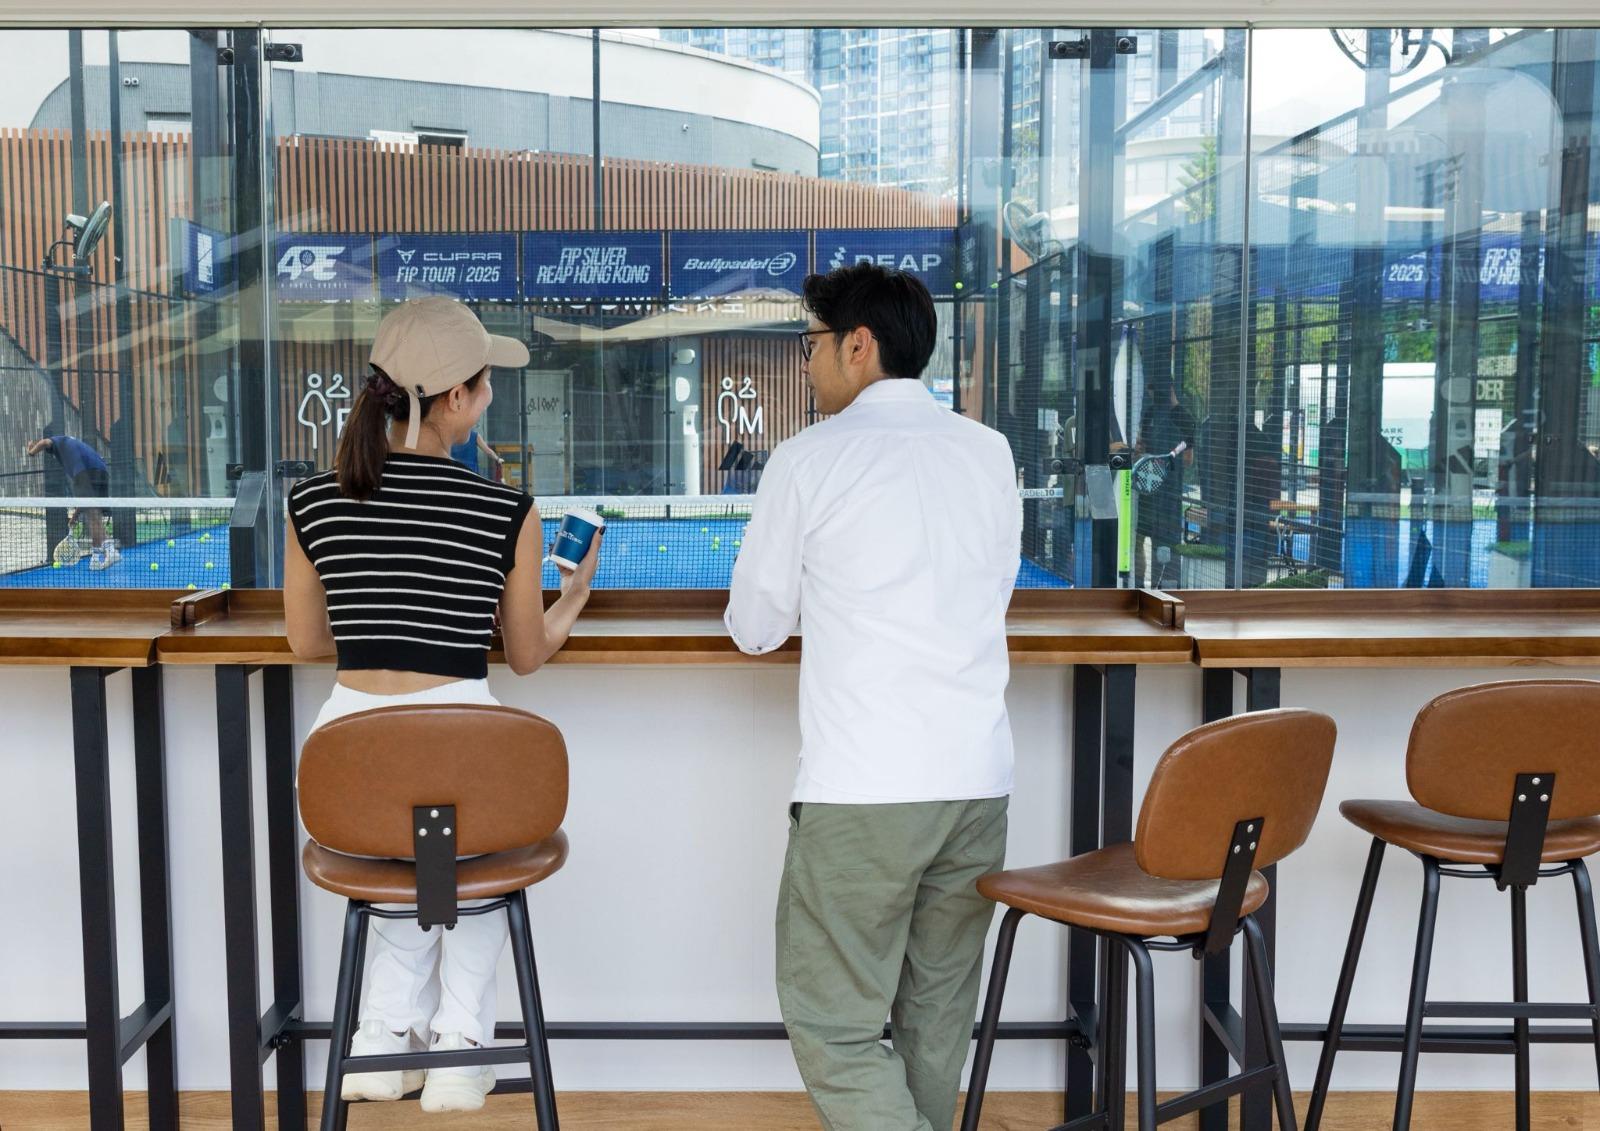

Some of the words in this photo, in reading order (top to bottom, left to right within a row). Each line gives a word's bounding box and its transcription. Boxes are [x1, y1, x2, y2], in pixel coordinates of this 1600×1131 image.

[423, 252, 502, 261] CUPRA
[559, 247, 582, 266] FIP
[581, 247, 627, 266] SILVER
[683, 257, 768, 273] Bullpadel
[396, 266, 419, 283] FIP
[422, 266, 456, 283] TOUR
[465, 266, 501, 283] 2025
[536, 265, 574, 284] REAP
[573, 265, 612, 284] HONG
[612, 265, 651, 284] KONG
[1388, 264, 1425, 282] 2025
[739, 405, 763, 435] M
